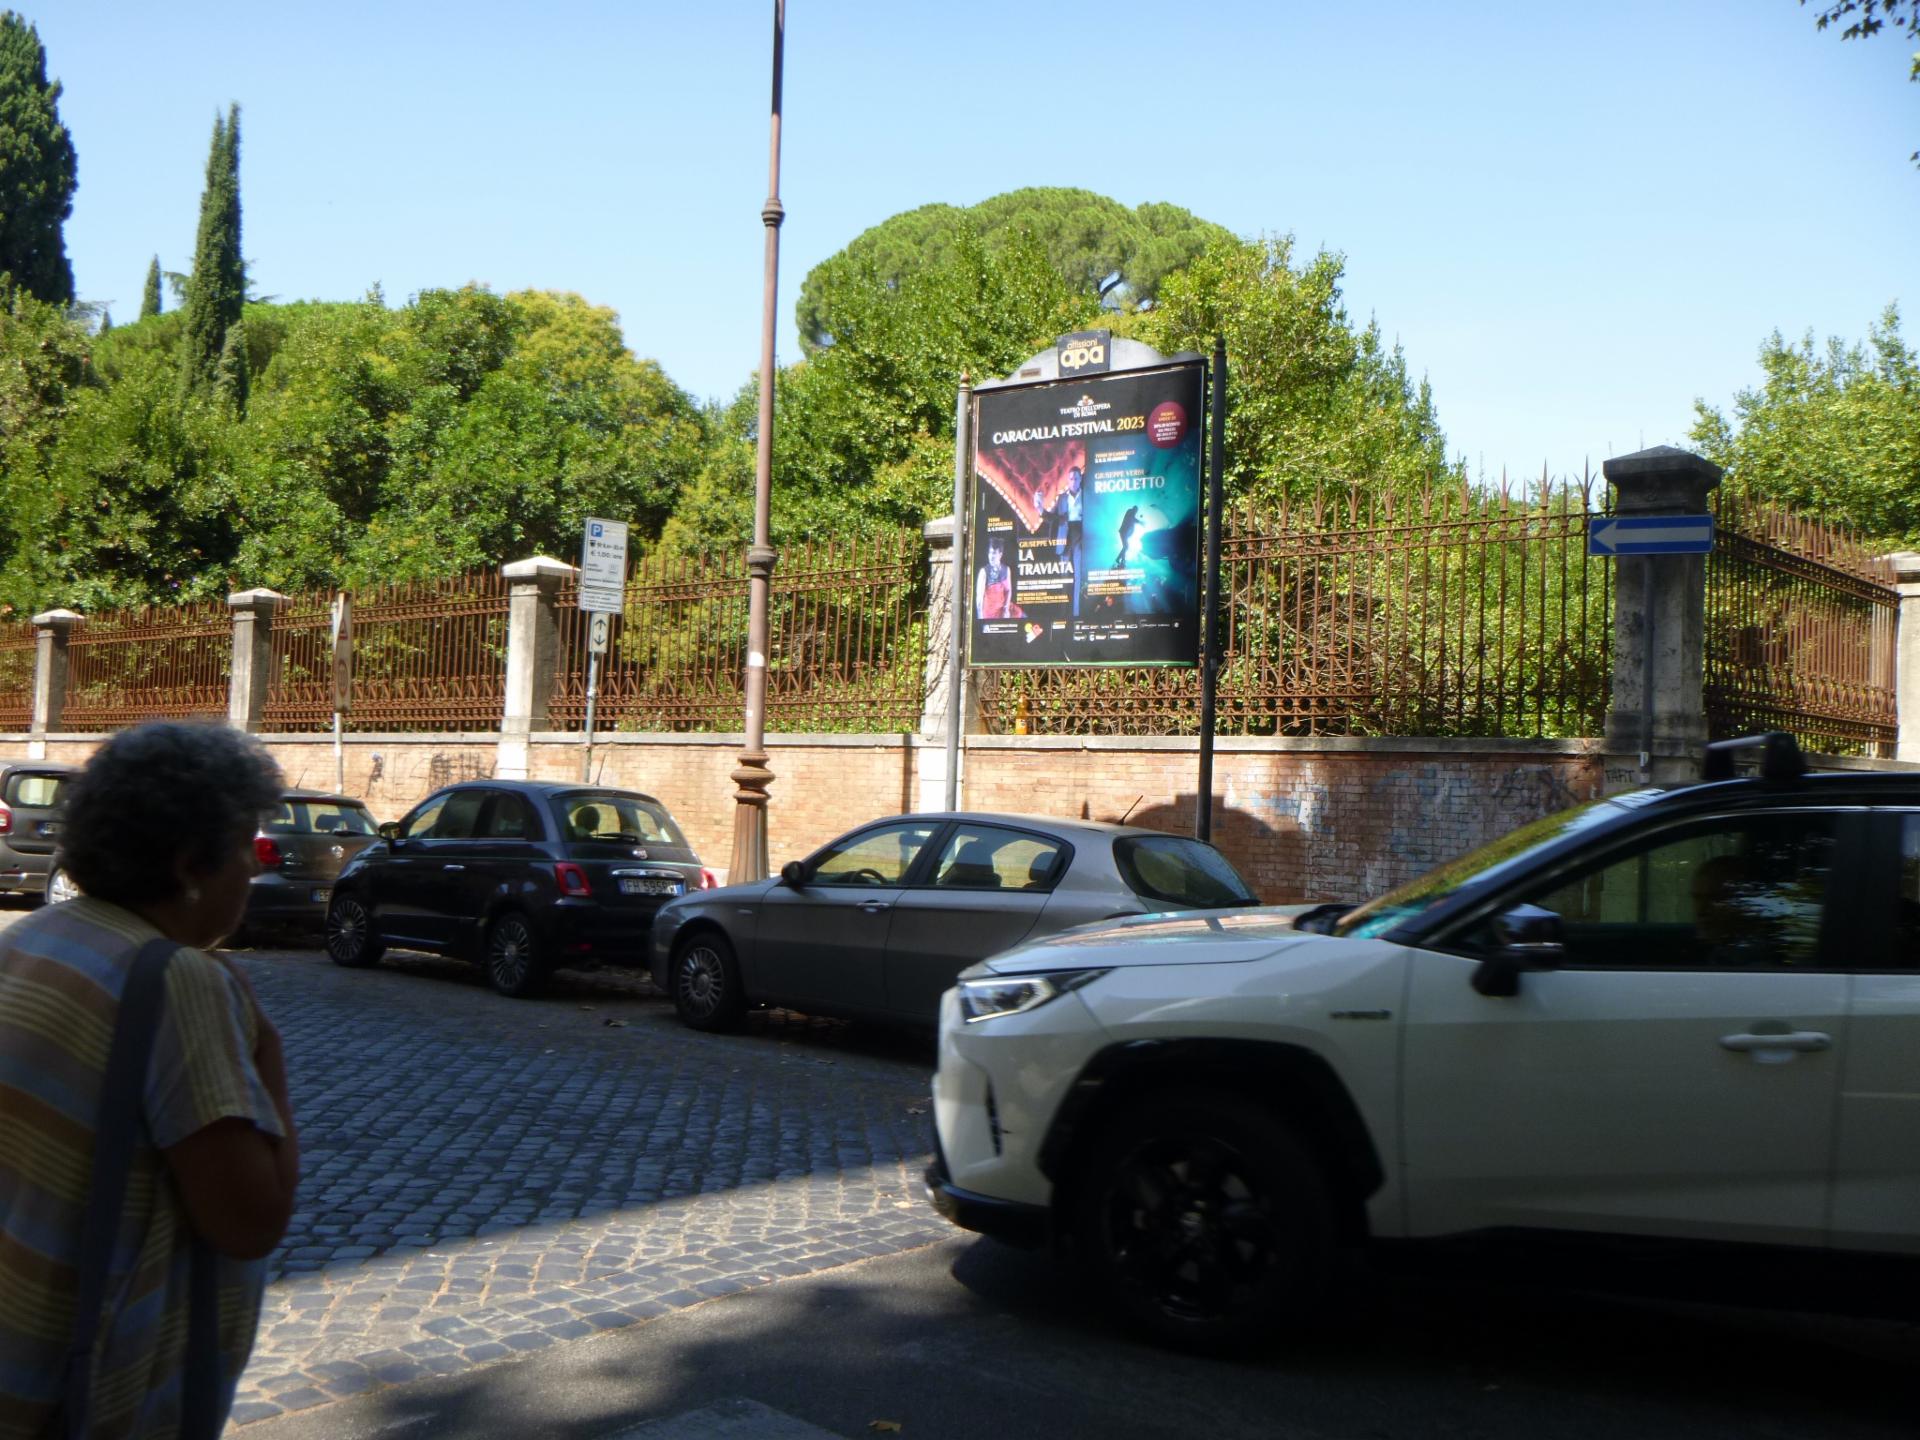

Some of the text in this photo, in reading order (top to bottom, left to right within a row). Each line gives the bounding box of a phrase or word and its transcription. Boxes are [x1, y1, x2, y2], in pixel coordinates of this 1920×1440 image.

[1061, 345, 1104, 370] apa
[993, 424, 1060, 445] CARACALLA
[1061, 419, 1115, 438] FESTIVAL
[1116, 416, 1145, 431] 2023
[1095, 475, 1165, 493] RIGOLETTO
[1018, 549, 1034, 561] LA
[1018, 562, 1074, 576] TRAVIATA
